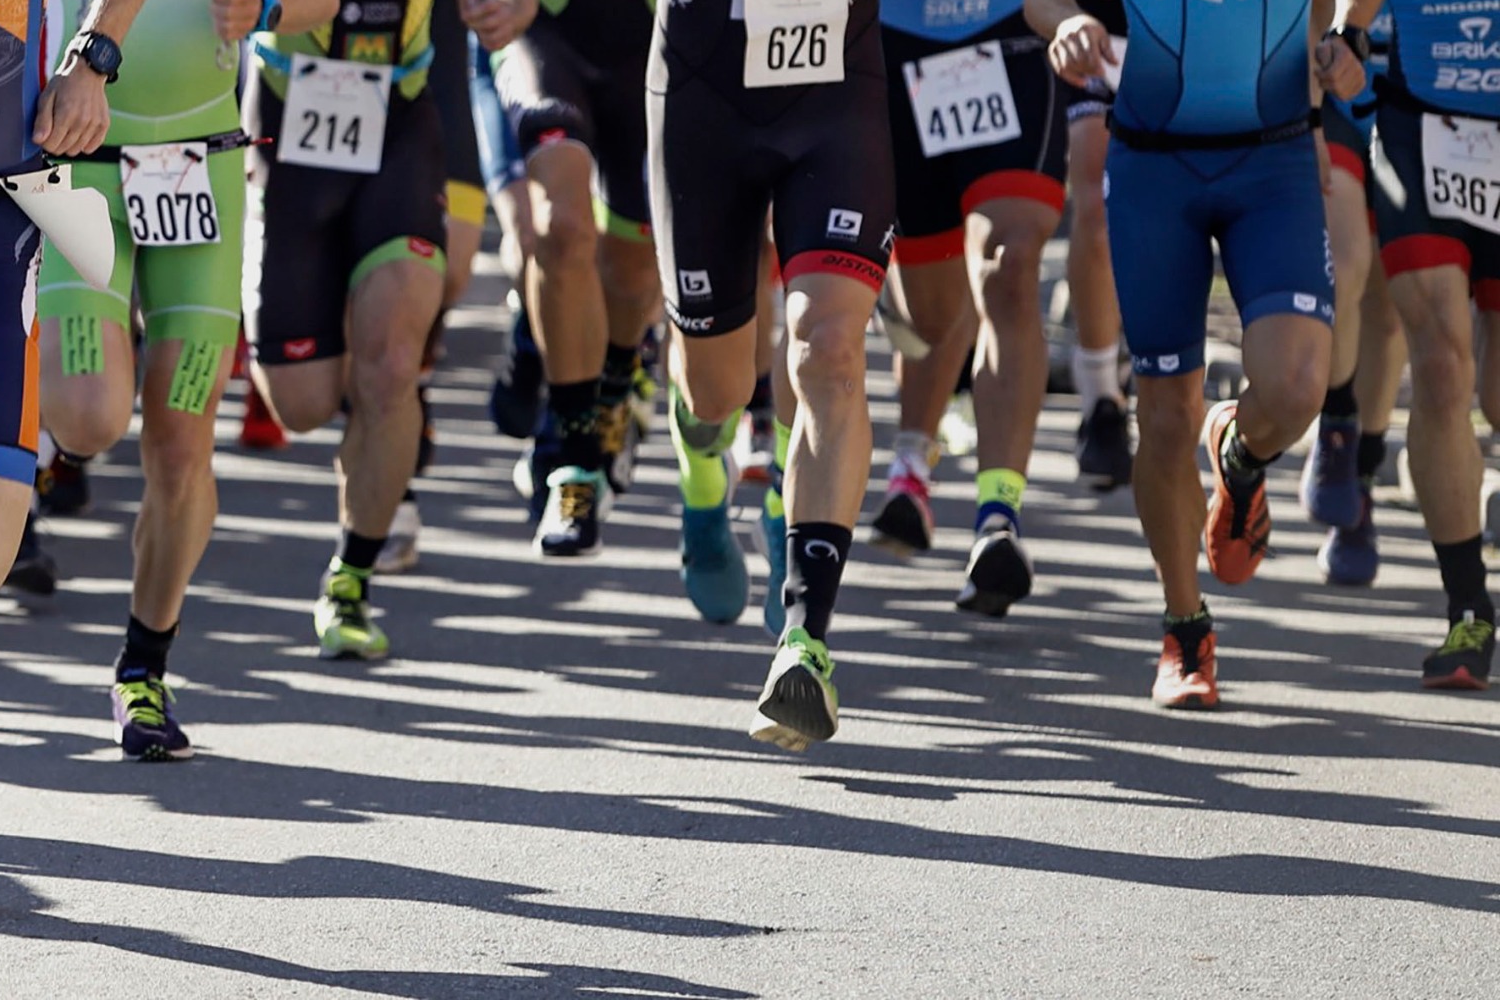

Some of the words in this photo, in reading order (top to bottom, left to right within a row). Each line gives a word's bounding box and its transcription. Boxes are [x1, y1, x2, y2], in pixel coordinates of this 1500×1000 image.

[766, 23, 828, 70] 626
[298, 109, 363, 156] 214
[928, 93, 1010, 142] 4128
[127, 192, 218, 242] 3.078
